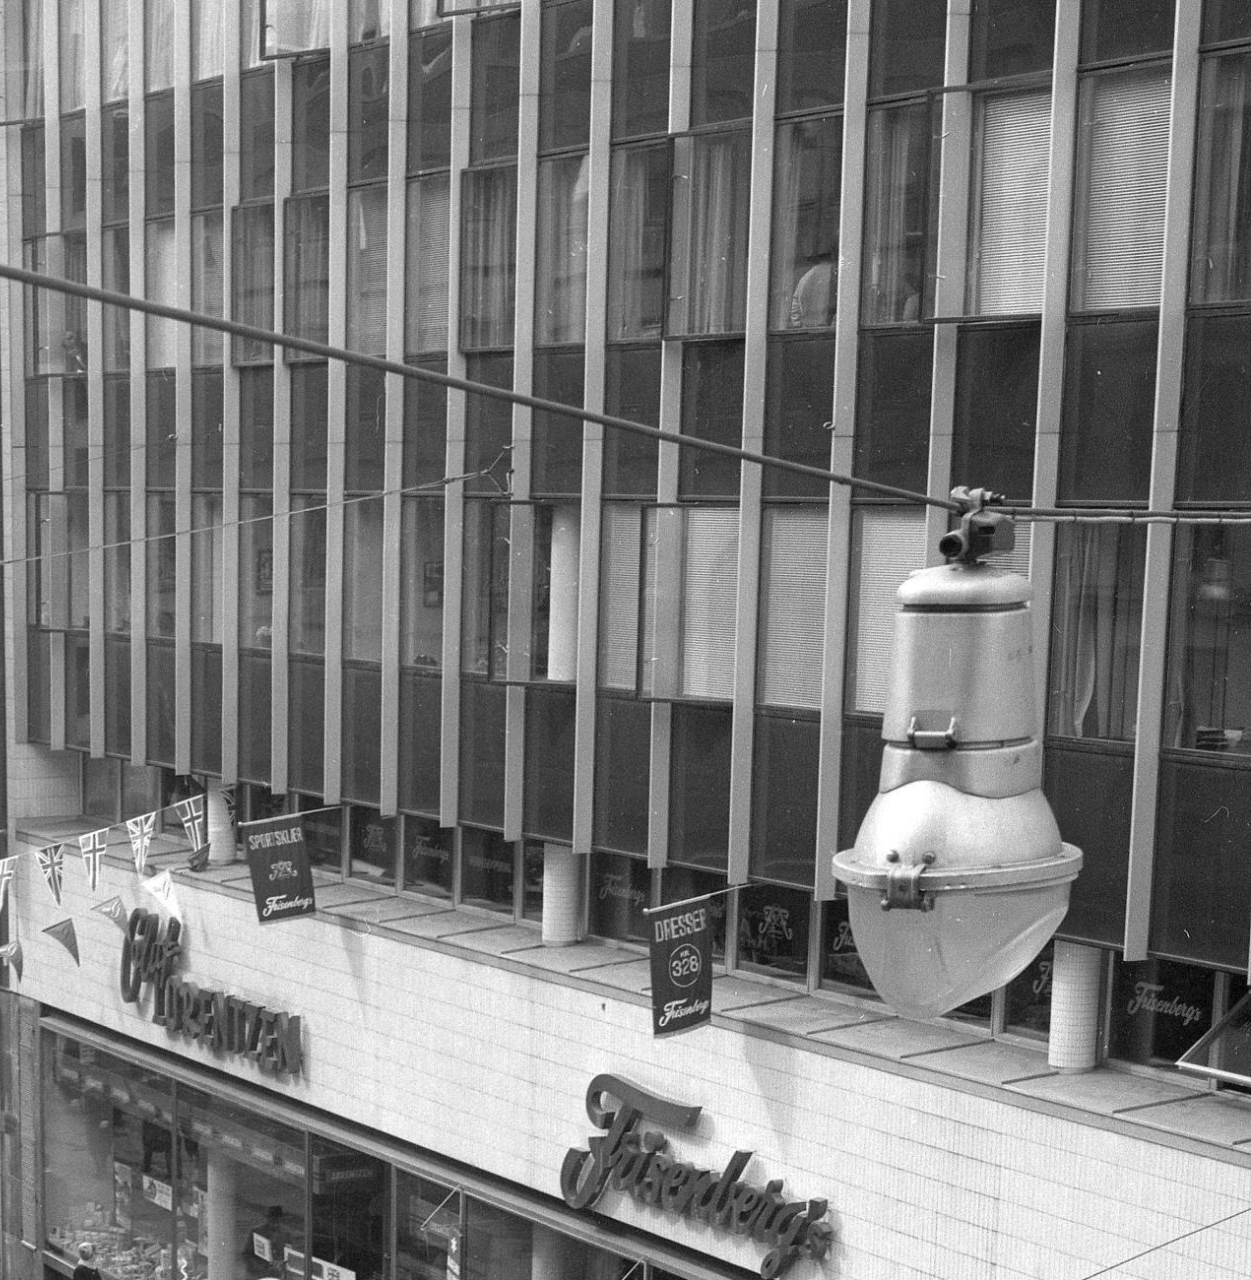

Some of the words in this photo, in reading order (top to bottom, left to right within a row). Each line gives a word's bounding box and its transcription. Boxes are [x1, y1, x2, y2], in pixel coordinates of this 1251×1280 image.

[248, 826, 303, 851] SPORTSKLÆR
[654, 907, 707, 943] DRESSER
[671, 955, 699, 978] 328
[152, 972, 303, 1076] LORENTZEN
